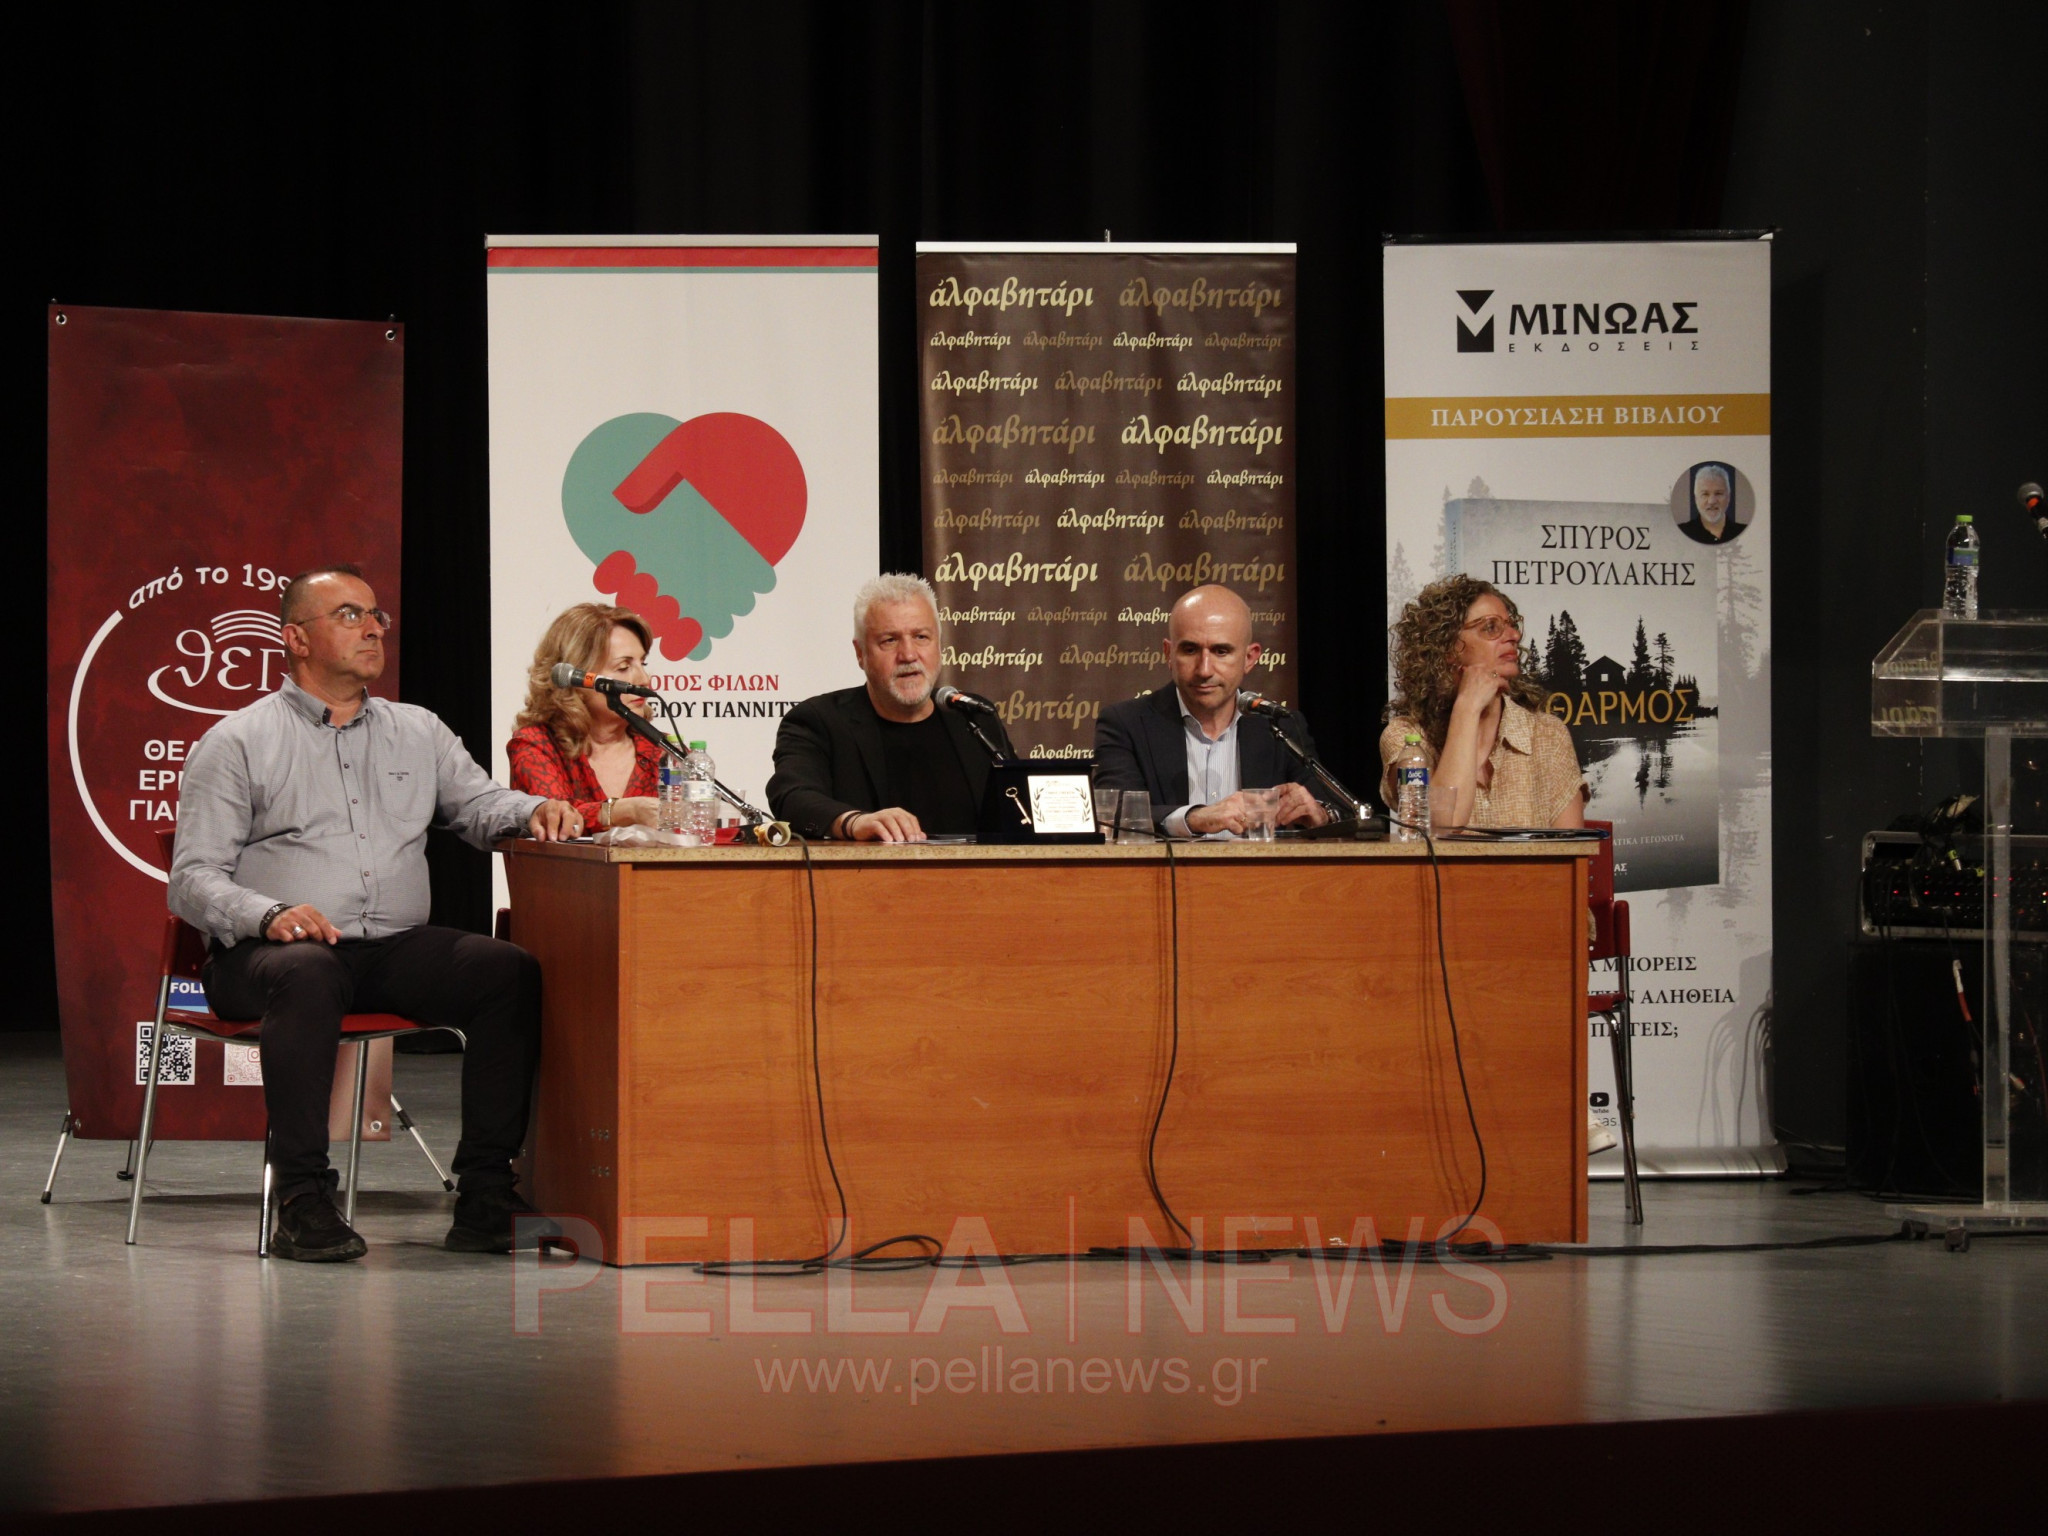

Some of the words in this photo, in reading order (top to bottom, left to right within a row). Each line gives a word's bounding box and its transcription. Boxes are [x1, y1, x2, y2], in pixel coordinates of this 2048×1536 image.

[1509, 301, 1699, 336] ΜΙΝΩΑΣ
[1508, 340, 1699, 353] ΕΚΔΟΣΕΙΣ
[1430, 407, 1604, 427] ΠΑΡΟΥΣΙΑΣΗ
[1613, 406, 1724, 425] ΒΙΒΛΙΟΥ
[1541, 524, 1651, 551] ΣΠΥΡΟΣ
[1491, 560, 1696, 586] ΠΕΤΡΟΥΛΑΚΗΣ
[128, 566, 184, 610] από
[195, 566, 229, 585] το
[707, 674, 779, 692] ΦΙΛΩΝ
[1640, 988, 1736, 1004] ΑΛΗΘΕΙΑ
